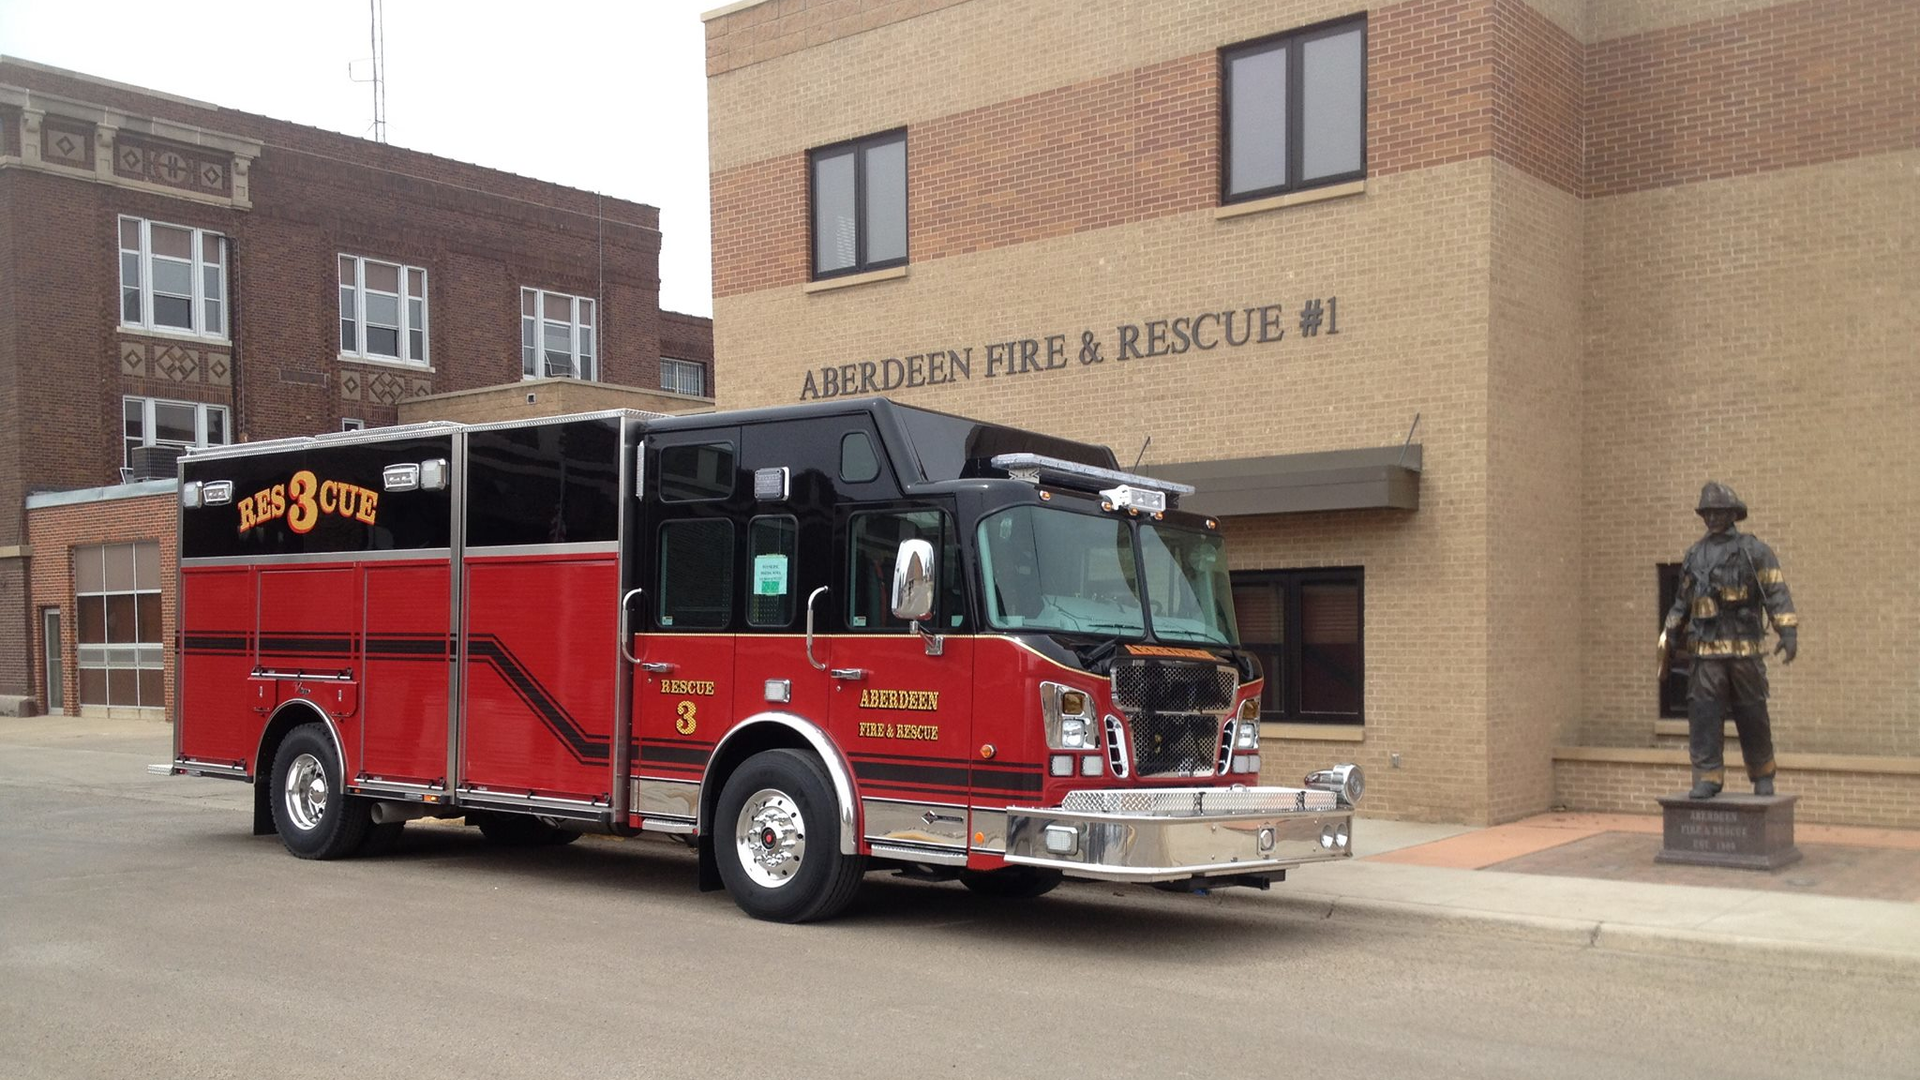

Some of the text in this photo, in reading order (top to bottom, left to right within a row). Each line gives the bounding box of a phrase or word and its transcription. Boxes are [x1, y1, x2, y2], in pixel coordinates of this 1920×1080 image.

[799, 296, 1341, 401] ABERDEEN FIRE & RESCUE #1
[660, 679, 715, 696] RESCUE
[859, 689, 939, 711] ABERDEEN
[675, 700, 697, 735] 3
[859, 722, 938, 741] FIRE & RESCUE
